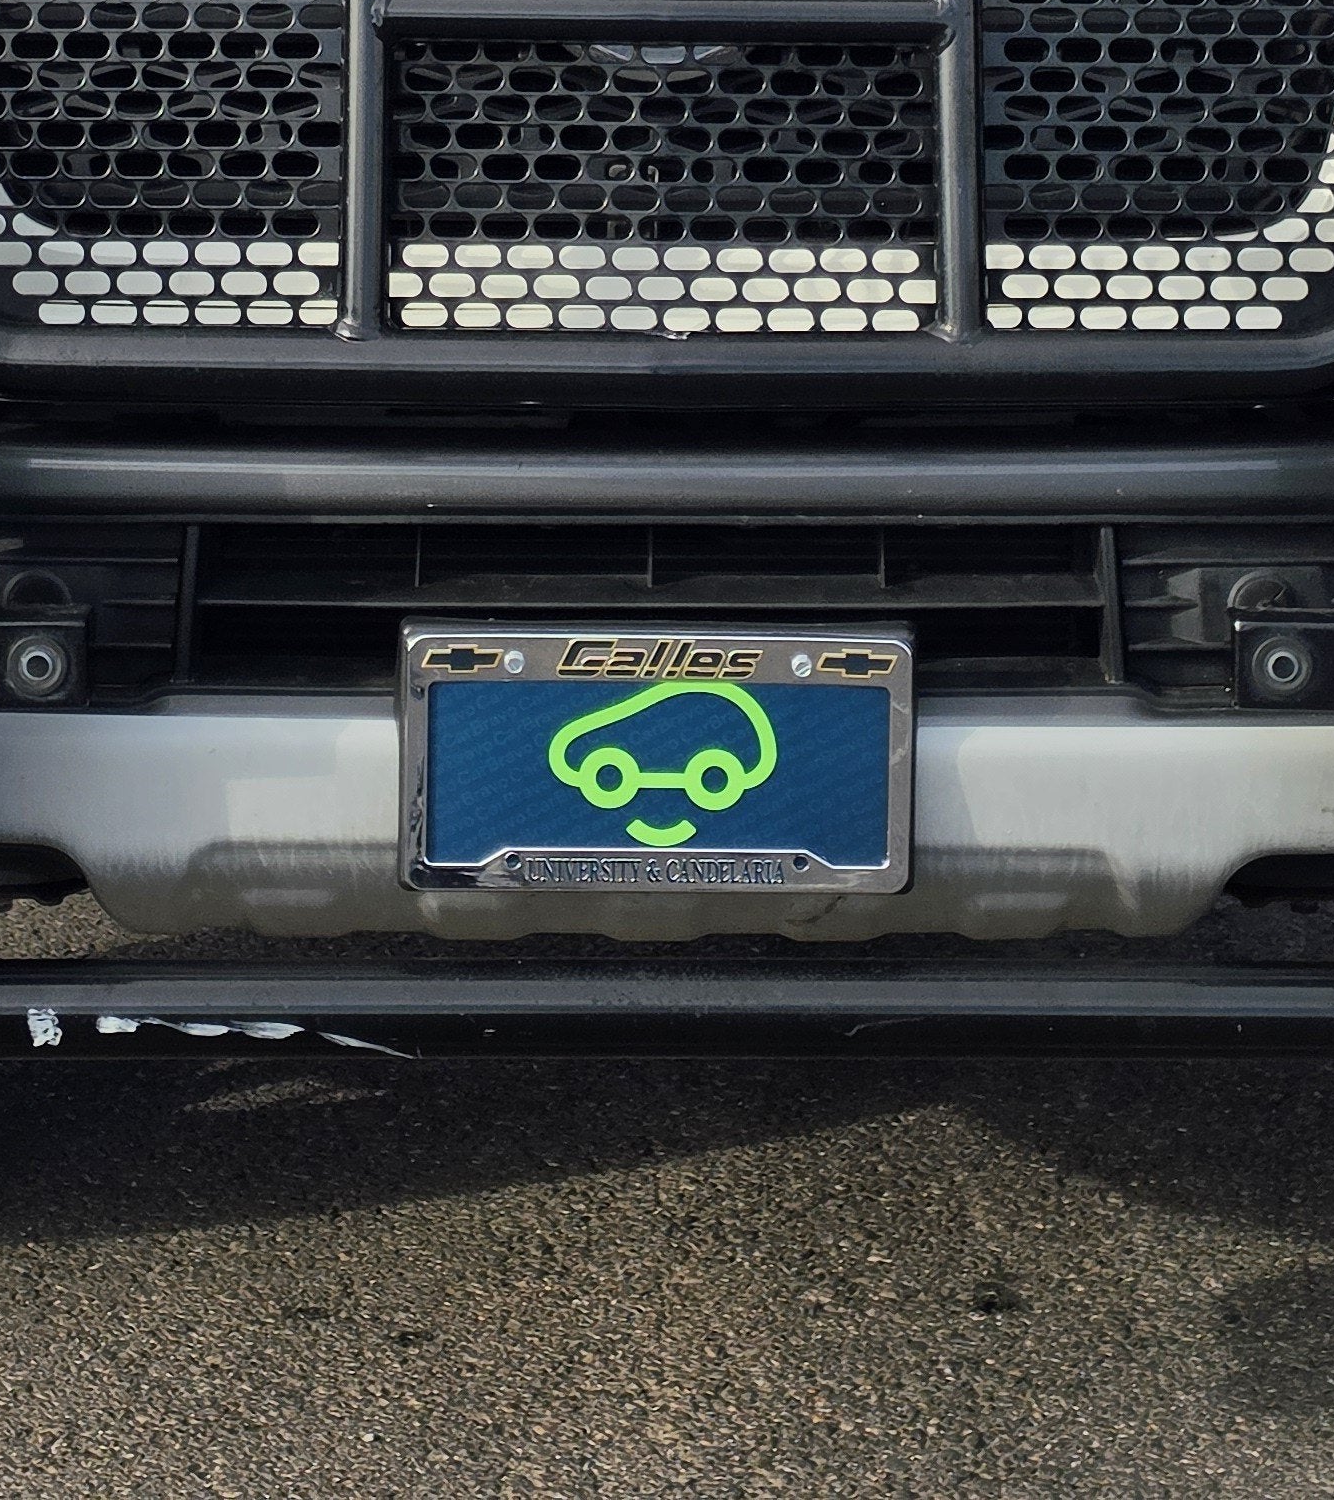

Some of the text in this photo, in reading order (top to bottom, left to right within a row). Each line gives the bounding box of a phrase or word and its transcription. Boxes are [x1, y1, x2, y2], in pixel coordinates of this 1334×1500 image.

[556, 639, 764, 680] Galles
[524, 857, 786, 884] UNIVERSITY & CANDELARIA
